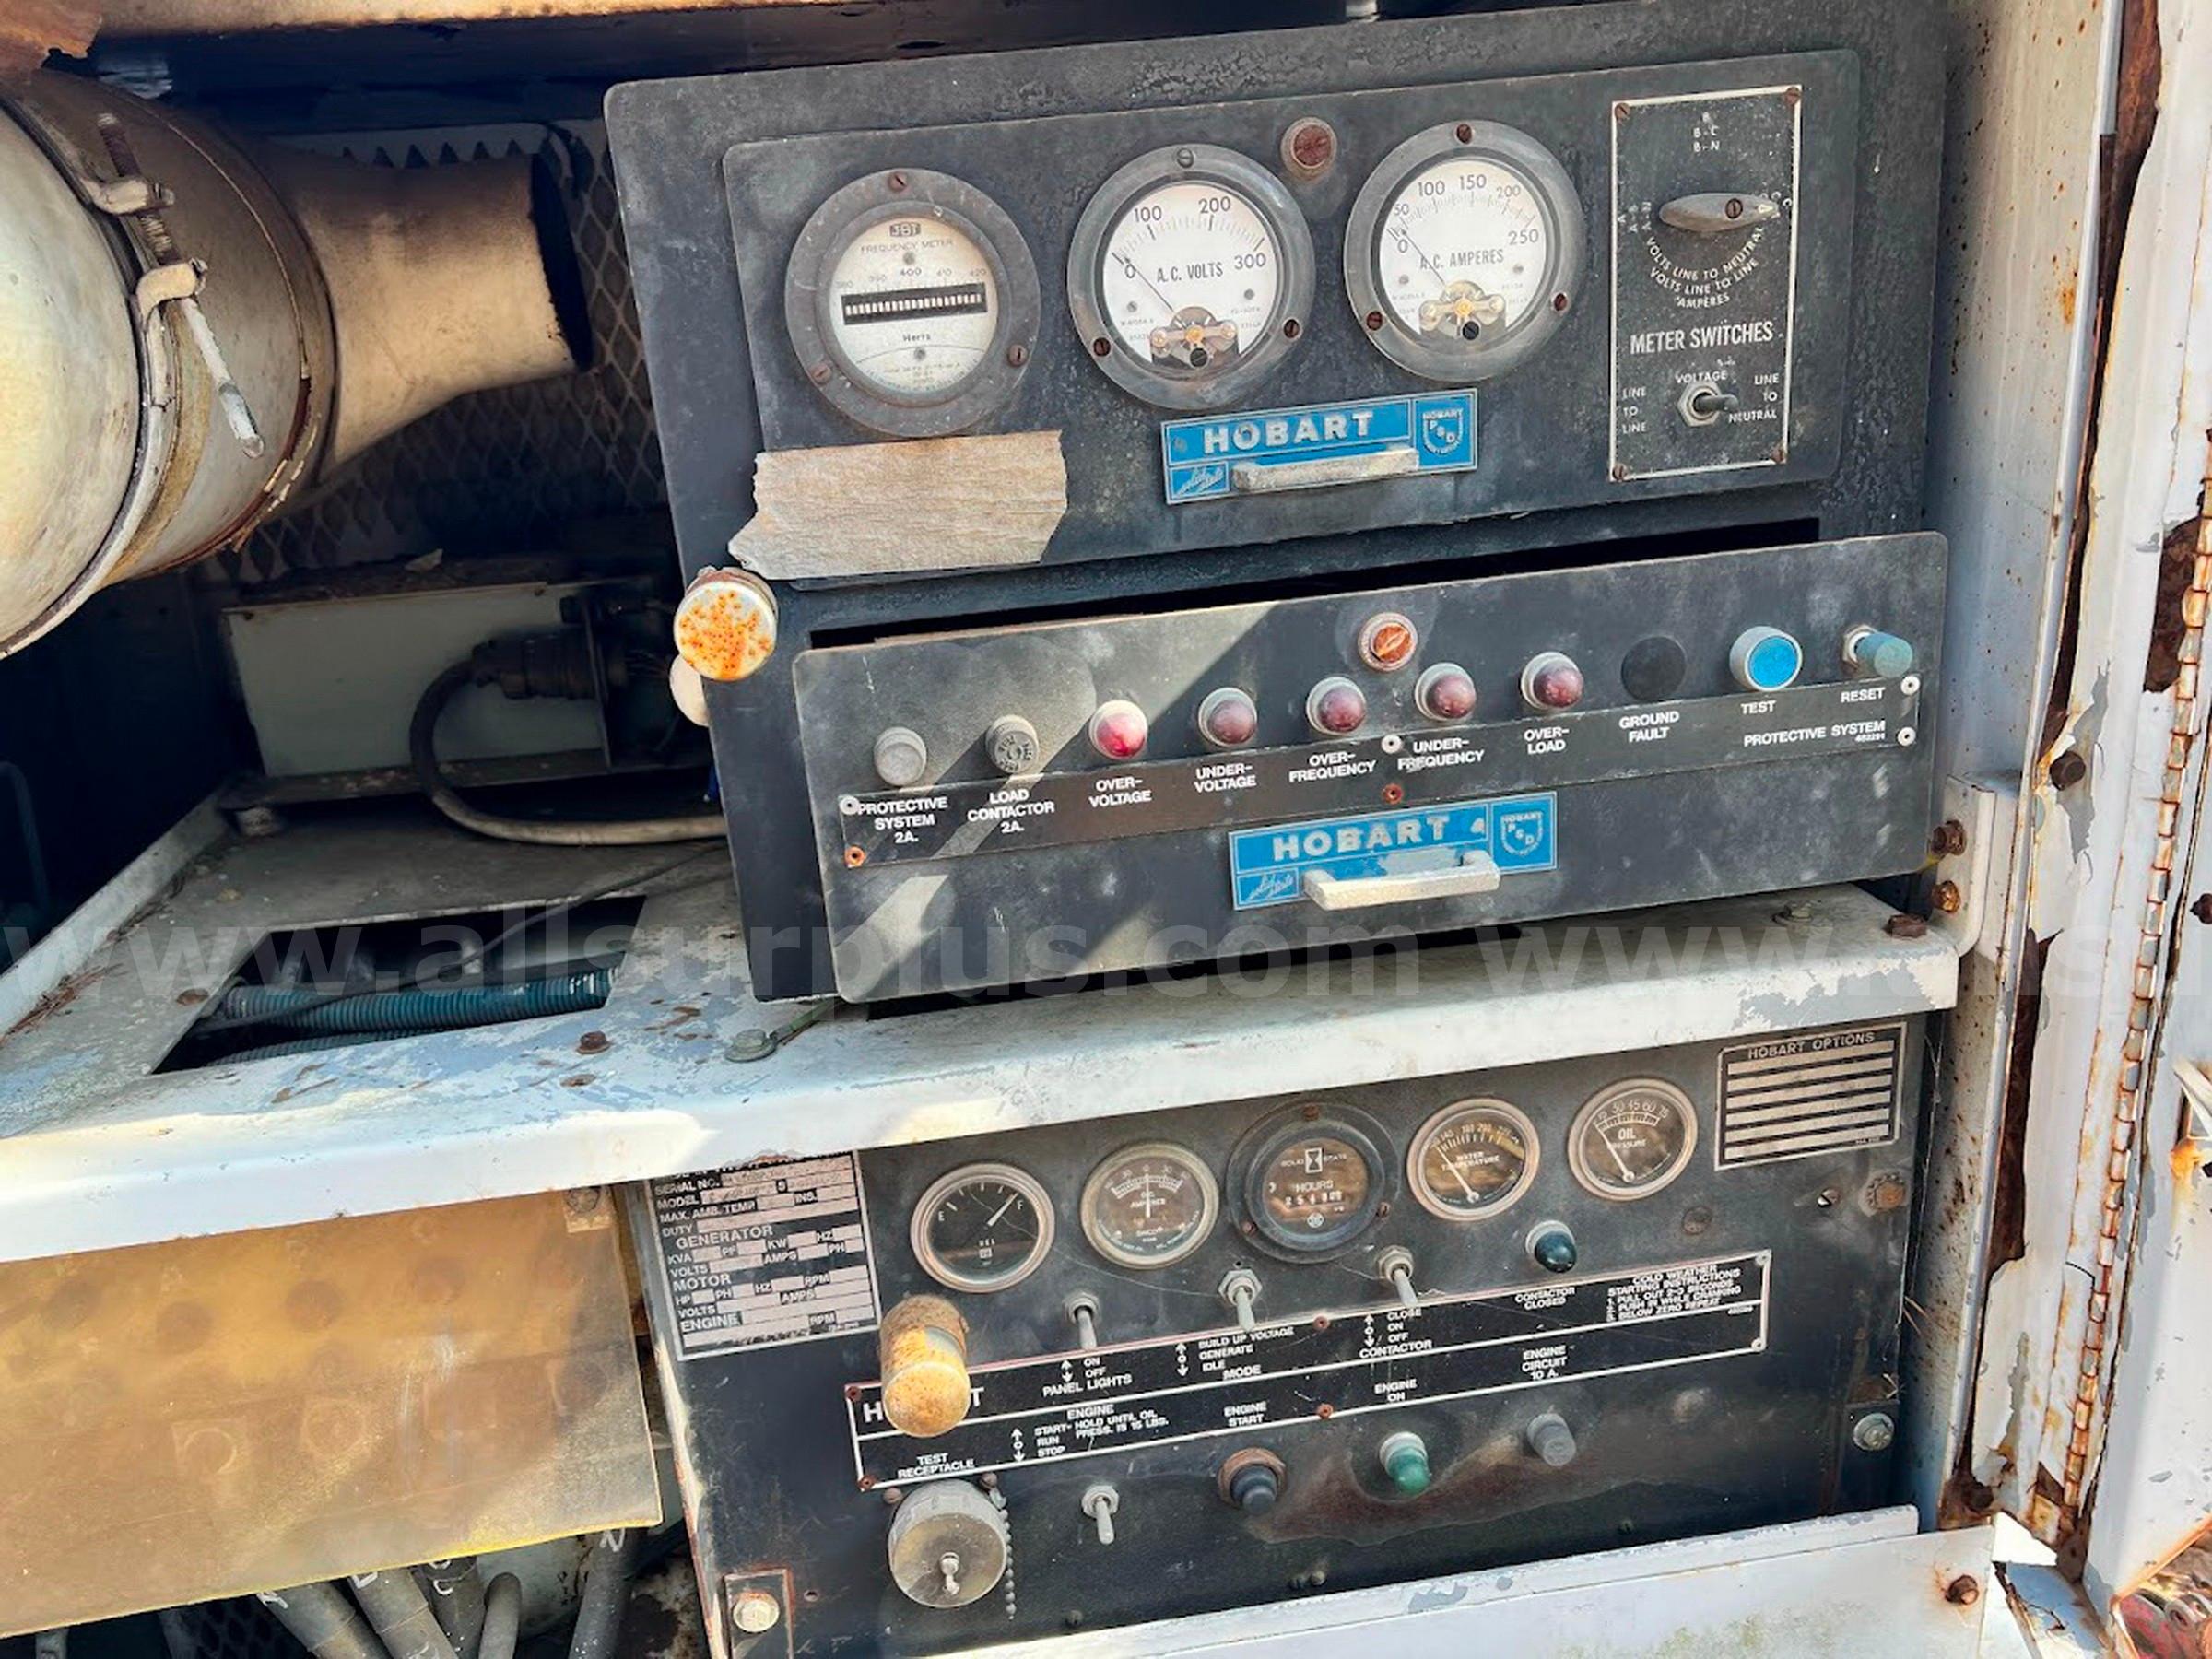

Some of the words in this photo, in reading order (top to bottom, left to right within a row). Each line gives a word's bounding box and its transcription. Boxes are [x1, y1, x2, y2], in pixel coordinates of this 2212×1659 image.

[1394, 203, 1410, 217] 50
[1418, 181, 1445, 197] 100
[1459, 173, 1488, 191] 150
[1496, 184, 1521, 198] 200
[1135, 205, 1162, 223] 100
[1198, 195, 1231, 214] 200
[861, 241, 918, 253] FREQUENCY
[922, 239, 953, 250] METER
[1397, 240, 1408, 254] 0
[1508, 229, 1539, 246] 250
[1450, 248, 1504, 268] AMPERES
[1647, 236, 1673, 271] VOLTS
[1672, 266, 1699, 281] LINE
[1703, 267, 1718, 280] TO
[1722, 226, 1765, 274] NEUTRAL
[900, 268, 922, 277] 400
[1124, 263, 1136, 279] 0
[1234, 253, 1266, 271] 300
[1188, 262, 1223, 280] VOLTS
[1650, 265, 1682, 293] VOLTS
[1684, 283, 1712, 296] LINE
[1714, 277, 1733, 291] TO
[1733, 257, 1759, 282] LINE
[1677, 292, 1730, 309] AMPERES
[1630, 329, 1686, 355] METER
[1689, 320, 1773, 349] SWITCHES
[1676, 370, 1728, 383] VOLTAGE
[1755, 372, 1780, 385] LINE
[1622, 386, 1647, 399] LINE
[1763, 391, 1778, 402] TO
[1623, 405, 1639, 417] TO
[1728, 410, 1777, 424] NEUTRAL
[1203, 410, 1373, 455] HOBART
[1622, 421, 1647, 434] LINE
[1840, 687, 1887, 703] RESET
[1740, 700, 1777, 715] TEST
[1618, 710, 1680, 730] GROUND
[1524, 726, 1570, 741] OVER-
[1628, 725, 1670, 743] FAULT
[1744, 726, 1827, 747] PROTECTIVE
[1830, 720, 1887, 737] SYSTEM
[1413, 736, 1470, 753] UNDER-
[1527, 739, 1566, 755] LOAD
[1309, 750, 1357, 767] OVER-
[1397, 749, 1485, 771] FREQUENCY
[1196, 763, 1253, 780] UNDER-
[1288, 760, 1377, 783] FREQUENCY
[1096, 776, 1143, 792] OVER-
[1194, 775, 1257, 793] VOLTAGE
[989, 788, 1030, 804] LOAD
[1088, 789, 1152, 807] VOLTAGE
[858, 795, 948, 815] PROTECTIVE
[968, 801, 1054, 822] CONTACTOR
[875, 814, 935, 831] SYSTEM
[1000, 820, 1025, 834] 2A.
[894, 830, 919, 844] 2A.
[1272, 815, 1451, 862] HOBART
[1747, 1042, 1805, 1059] HOBART
[1812, 1031, 1876, 1051] OPTIONS
[1628, 1099, 1640, 1111] 45
[1618, 1128, 1637, 1140] OIL
[1295, 1179, 1335, 1193] HOURS
[656, 1196, 700, 1210] MODEL
[938, 1210, 945, 1222] E
[1017, 1199, 1024, 1211] F
[660, 1211, 691, 1224] MAX.
[691, 1206, 722, 1219] AMB.
[662, 1225, 693, 1238] DUTY
[676, 1224, 773, 1250] GENERATOR
[667, 1253, 691, 1266] KVA
[767, 1239, 788, 1251] KW
[817, 1230, 833, 1242] HZ
[670, 1263, 709, 1278] VOLTS
[762, 1251, 798, 1265] AMPS
[830, 1242, 845, 1254] PH
[673, 1273, 732, 1292] MOTOR
[1607, 1281, 1661, 1298] STARTING
[1662, 1267, 1741, 1289] INSTRUCTIONS
[1632, 1273, 1664, 1287] COLD
[1667, 1265, 1718, 1281] WEATHER
[677, 1295, 691, 1306] HP
[715, 1288, 733, 1300] PH
[755, 1281, 771, 1293] HZ
[804, 1273, 830, 1286] RPM
[1514, 1286, 1576, 1304] CONTACTOR
[1618, 1292, 1640, 1305] PULL
[1643, 1289, 1665, 1301] OUT
[1687, 1279, 1735, 1295] SECONDS
[678, 1305, 716, 1319] VOLTS
[781, 1290, 816, 1304] AMPS
[1524, 1296, 1567, 1311] CLOSED
[1618, 1300, 1645, 1313] PUSH
[1648, 1299, 1659, 1308] IN
[1661, 1292, 1690, 1307] WHILE
[1387, 1308, 1423, 1321] CLOSE
[1618, 1307, 1653, 1321] BELOW
[1656, 1302, 1684, 1315] ZERO
[680, 1314, 739, 1333] ENGINE
[809, 1312, 836, 1325] RPM
[1387, 1321, 1405, 1333] ON
[1198, 1336, 1230, 1350] BUILD
[1232, 1334, 1248, 1345] UP
[1250, 1326, 1295, 1343] VOLTAGE
[1387, 1332, 1410, 1345] OFF
[1198, 1343, 1254, 1361] GENERATE
[1359, 1339, 1433, 1360] CONTACTOR
[1522, 1344, 1567, 1360] ENGINE
[1083, 1357, 1101, 1368] ON
[1201, 1361, 1227, 1373] IDLE
[1521, 1356, 1568, 1372] CIRCUIT
[1085, 1366, 1108, 1379] OFF
[1222, 1364, 1263, 1381] MODE
[1530, 1370, 1545, 1381] 10
[1042, 1382, 1084, 1398] PANEL
[1087, 1373, 1134, 1390] LIGHTS
[1374, 1378, 1418, 1394] ENGINE
[1386, 1392, 1406, 1403] ON
[1066, 1403, 1115, 1420] ENGINE
[1223, 1400, 1268, 1418] ENGINE
[1075, 1418, 1104, 1430] HOLD
[1107, 1412, 1137, 1426] UNTIL
[1139, 1409, 1158, 1420] OIL
[1076, 1427, 1114, 1439] PRESS.
[1116, 1423, 1127, 1432] IS
[1145, 1417, 1170, 1429] LBS.
[1228, 1413, 1265, 1428] START
[1036, 1435, 1060, 1447] RUN
[916, 1452, 949, 1466] TEST
[1037, 1445, 1066, 1458] STOP
[897, 1458, 976, 1479] RECEPTACLE
